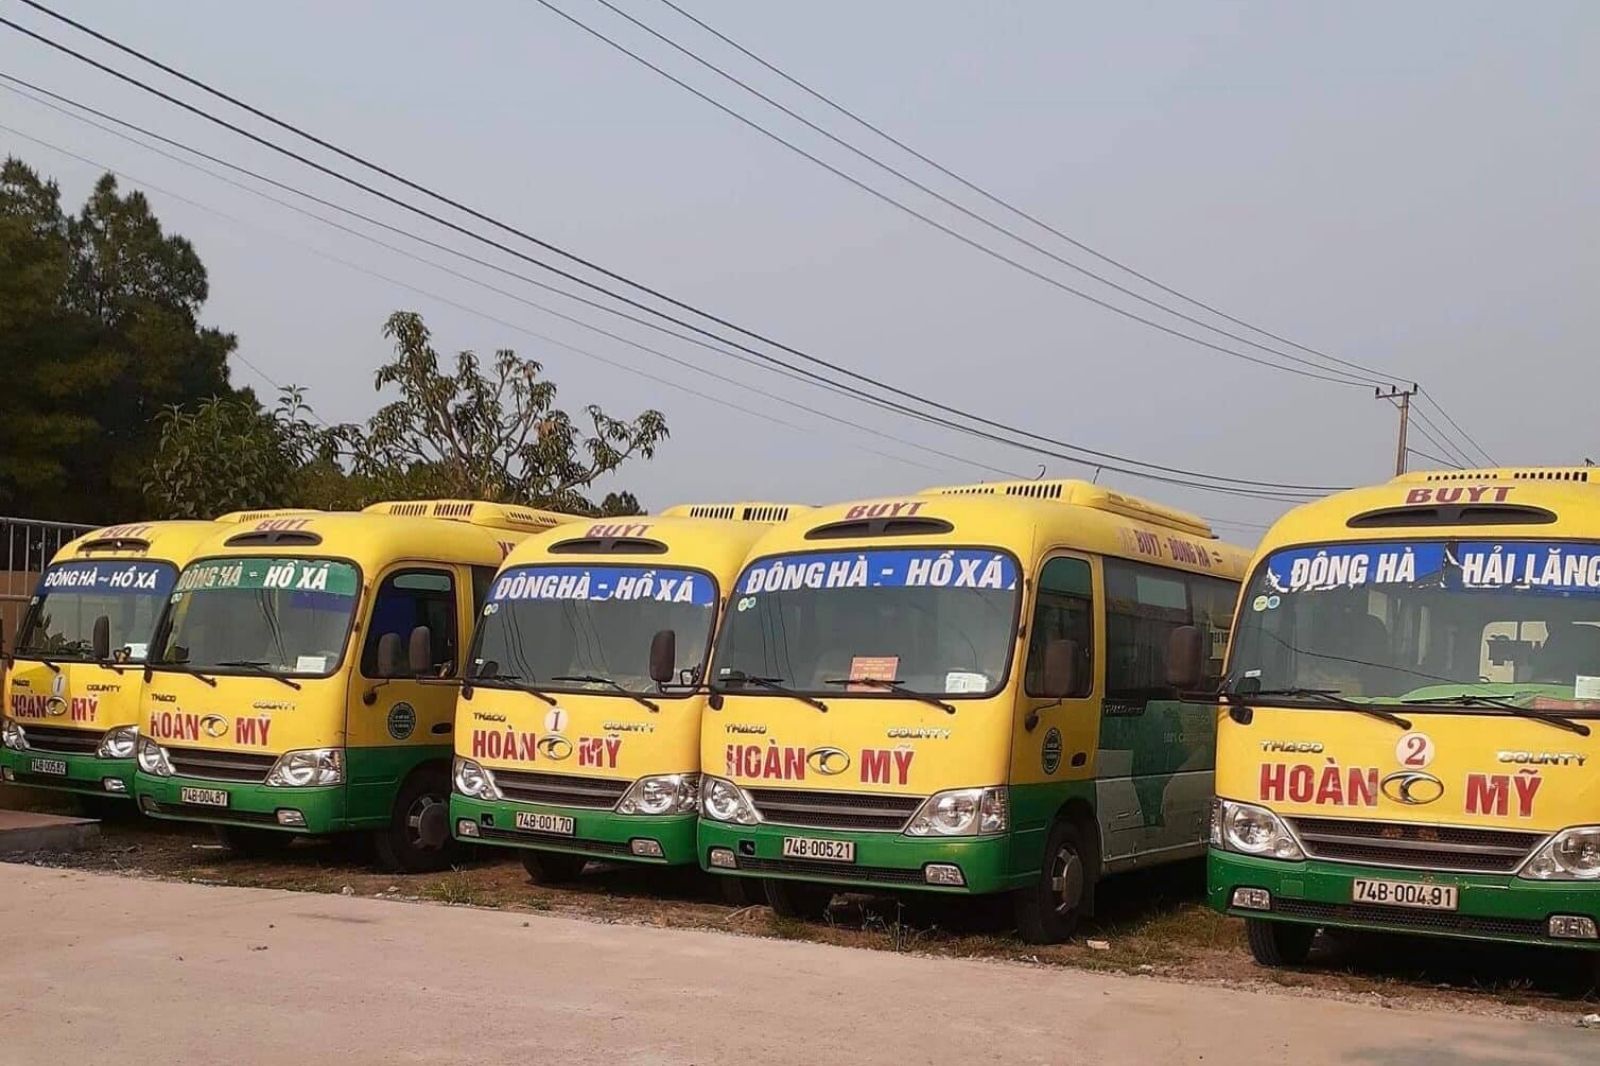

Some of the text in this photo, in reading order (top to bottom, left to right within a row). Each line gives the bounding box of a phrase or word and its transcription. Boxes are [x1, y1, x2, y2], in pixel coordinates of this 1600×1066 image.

[134, 569, 159, 589] XÁ
[296, 563, 329, 590] XÁ
[826, 555, 868, 588] HÀ
[954, 555, 1003, 588] XÁ
[1289, 545, 1600, 587] ĐÔNG HÀ HẢI LĂNG
[655, 576, 694, 603] XÁ
[150, 707, 199, 741] HOÀN
[887, 728, 952, 740] COUNTY
[473, 725, 622, 768] HOÀN MỸ
[1260, 741, 1325, 754] THACO
[1404, 737, 1427, 766] 2
[1495, 750, 1588, 767] COUNTY
[725, 739, 915, 785] HOÀN MỸ
[1259, 757, 1543, 817] HOÀN MỸ
[518, 814, 573, 832] 74B-001.70
[785, 839, 852, 859] 74B-005.21
[1356, 881, 1452, 907] 74B-004.91
